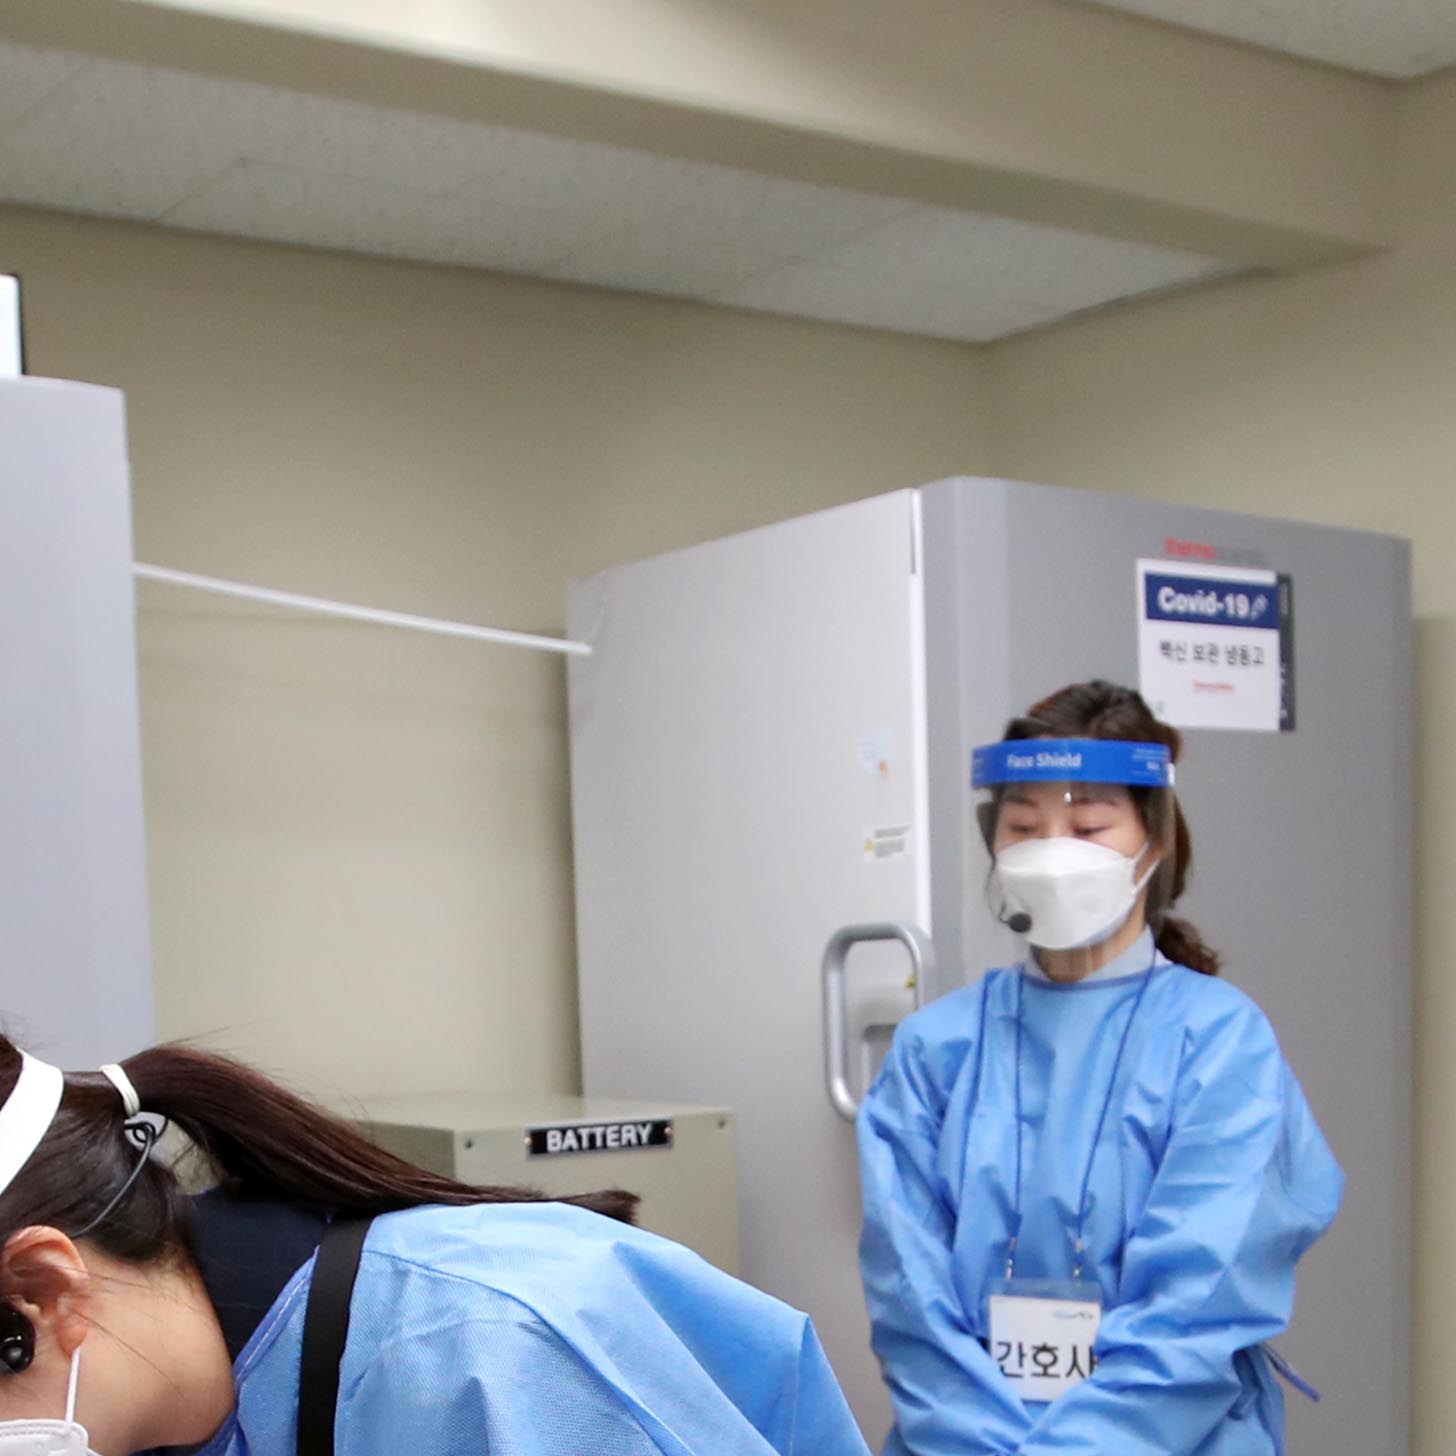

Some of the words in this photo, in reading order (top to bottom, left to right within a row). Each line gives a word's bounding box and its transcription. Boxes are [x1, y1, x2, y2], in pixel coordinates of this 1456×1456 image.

[1157, 585, 1250, 619] Covid-19
[1006, 753, 1035, 768] Face
[1036, 752, 1082, 768] Shield
[546, 1122, 654, 1152] BATTERY
[997, 1341, 1099, 1379] 간호사
